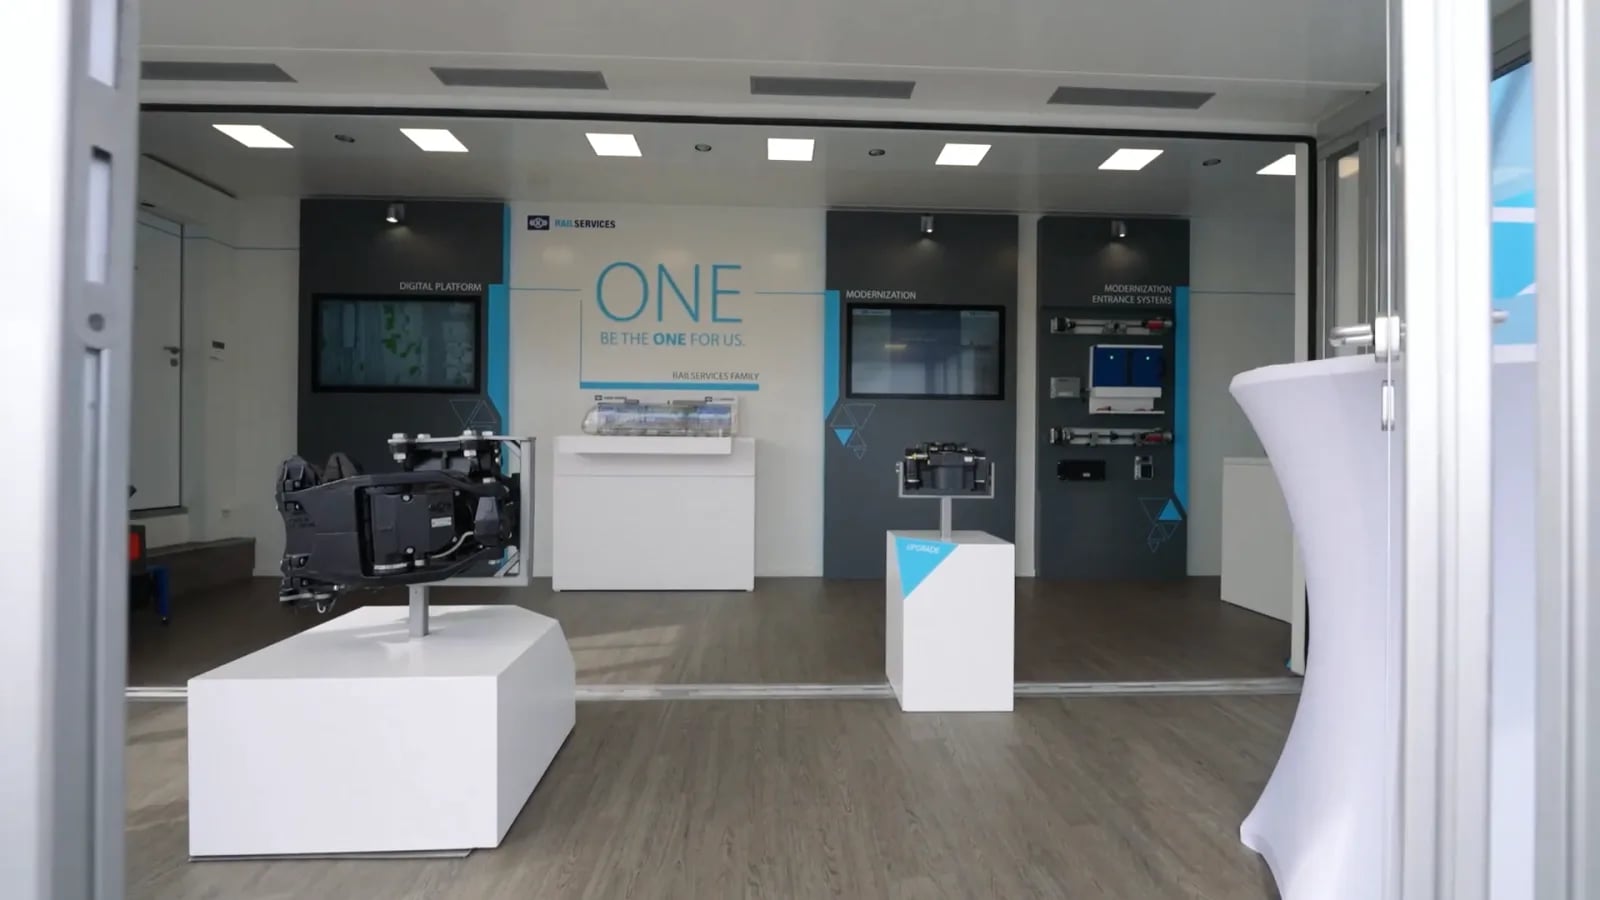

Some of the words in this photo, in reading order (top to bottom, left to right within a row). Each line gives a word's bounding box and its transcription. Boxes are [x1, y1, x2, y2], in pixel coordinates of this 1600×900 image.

[399, 281, 433, 291] DIGITAL
[434, 282, 482, 292] PLATFORM
[596, 261, 743, 323] ONE
[1104, 283, 1172, 294] MODERNIZATION
[845, 289, 917, 300] MODERNIZATION
[1092, 294, 1135, 304] ENTRANCE
[1136, 295, 1173, 305] SYSTEMS
[600, 331, 618, 345] BE
[621, 332, 649, 346] THE
[653, 332, 687, 346] ONE
[690, 332, 720, 346] FOR
[723, 333, 746, 347] US.
[730, 371, 760, 381] FAMILY
[905, 543, 940, 554] UPGRADE
